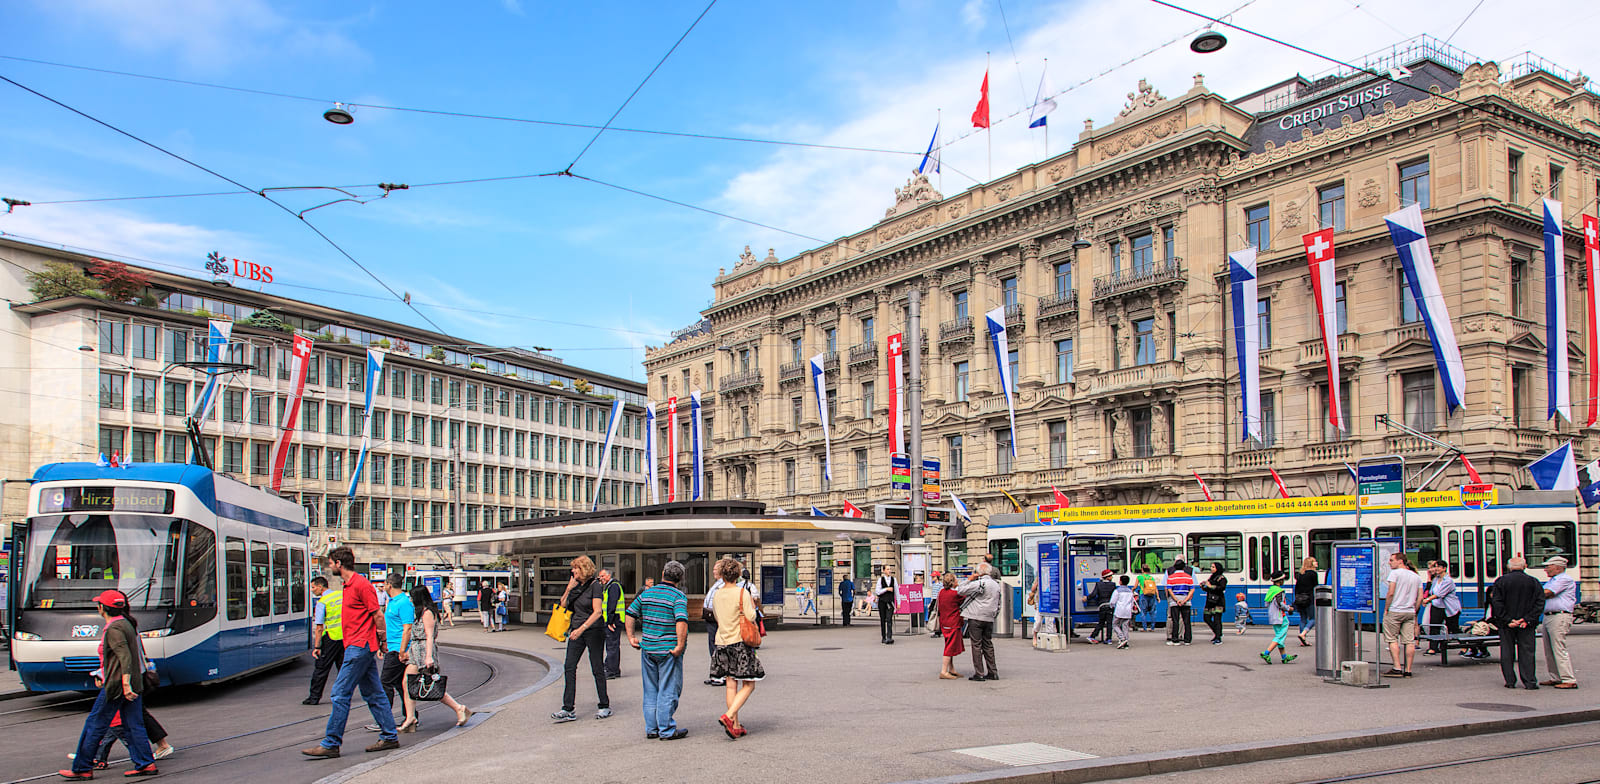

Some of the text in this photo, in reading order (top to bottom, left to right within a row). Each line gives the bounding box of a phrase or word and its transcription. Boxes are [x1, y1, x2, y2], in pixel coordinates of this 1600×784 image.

[1279, 82, 1393, 130] CREDIT SUISSE
[233, 258, 273, 283] UBS
[53, 492, 165, 506] 9 Hirzenbach
[1063, 510, 1079, 518] Falls
[1080, 509, 1099, 517] Ihnen
[1100, 508, 1122, 516] dieses
[1123, 507, 1140, 515] Tram
[1142, 507, 1166, 517] gerade
[1180, 505, 1193, 513] der
[1194, 505, 1213, 513] Nase
[1214, 503, 1256, 513] abgefahren
[1257, 502, 1267, 510] ist
[1275, 501, 1296, 509] 0444
[1297, 500, 1312, 508] 444
[1331, 499, 1346, 507] und
[1420, 494, 1456, 504] gerufen.
